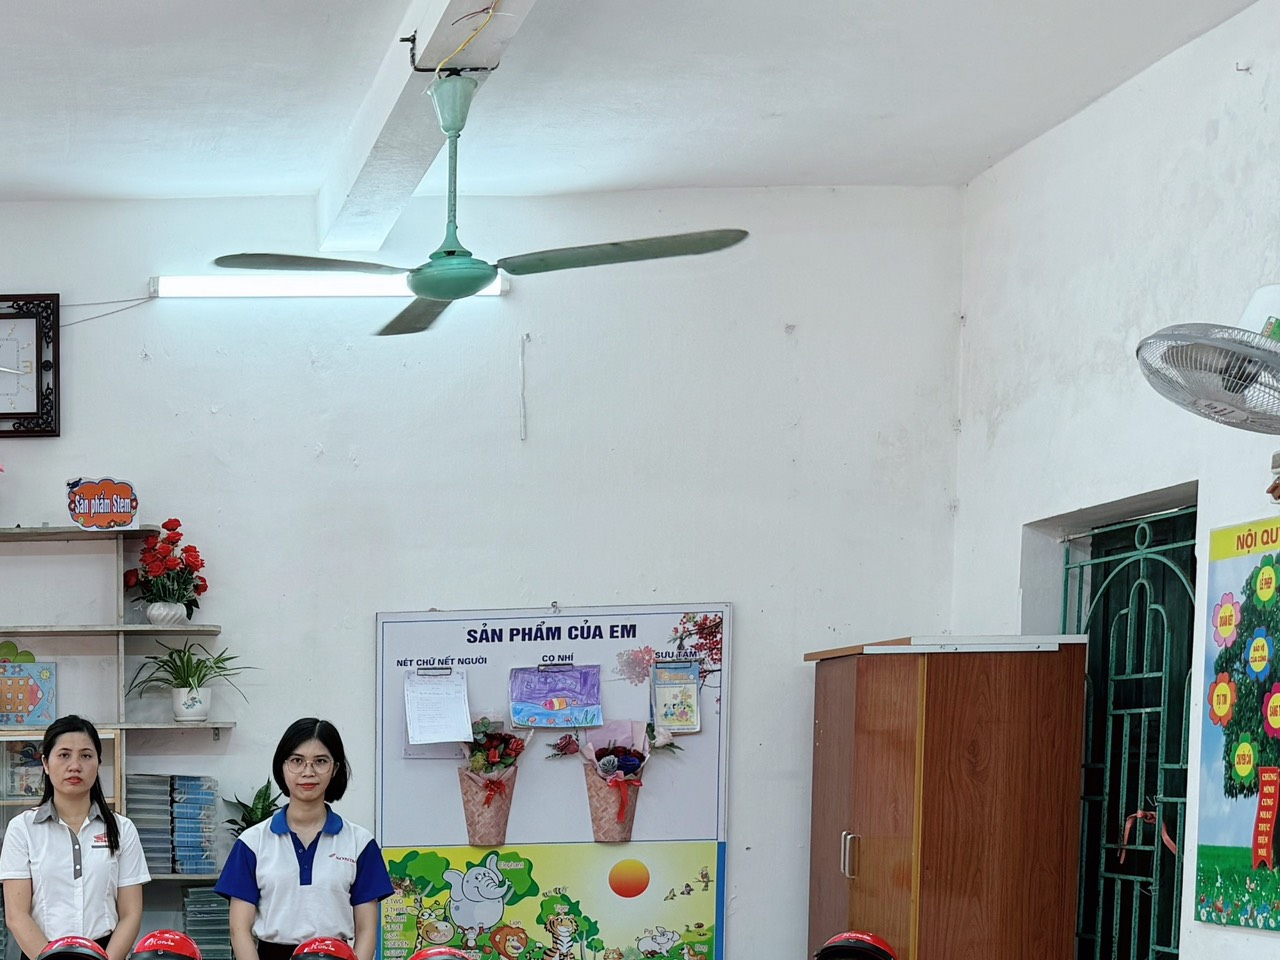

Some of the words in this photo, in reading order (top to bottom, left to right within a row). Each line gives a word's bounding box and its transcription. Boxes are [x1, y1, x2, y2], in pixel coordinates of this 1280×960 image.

[75, 494, 89, 514] Sản
[91, 490, 111, 518] phẩm
[112, 494, 131, 513] Stem
[1236, 529, 1257, 554] NỘI
[1261, 527, 1280, 546] QU
[467, 622, 503, 643] SẢN
[509, 621, 562, 642] PHẨM
[567, 620, 604, 640] CỦA
[609, 624, 637, 638] EM
[396, 658, 414, 667] NÉT
[416, 657, 436, 667] CHỮ
[456, 656, 487, 665] NGƯỜI
[558, 652, 574, 662] NHÍ
[655, 651, 675, 659] SƯU
